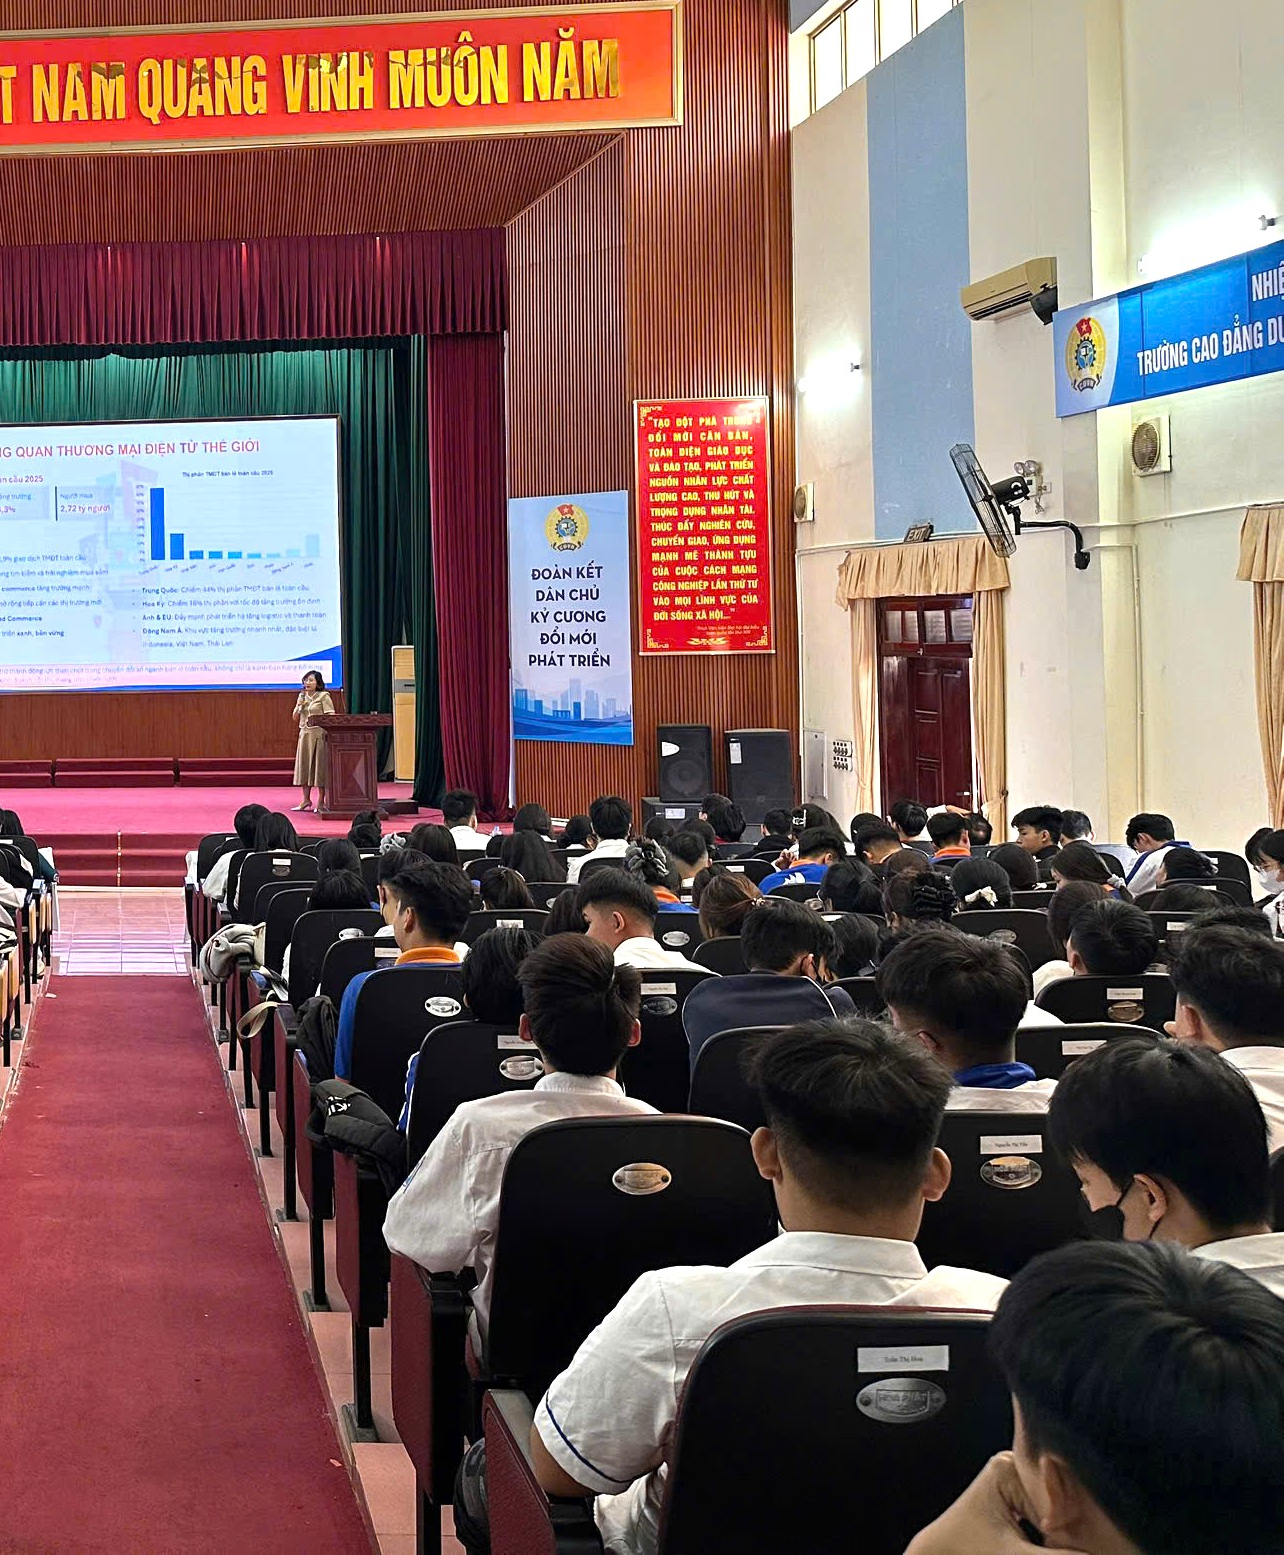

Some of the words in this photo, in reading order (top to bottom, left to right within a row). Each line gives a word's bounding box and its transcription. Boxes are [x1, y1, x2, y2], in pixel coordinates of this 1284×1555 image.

[33, 62, 126, 123] NAM
[138, 54, 267, 125] QUANG
[282, 51, 374, 113] VINH
[388, 31, 509, 109] MUÔN
[522, 25, 621, 102] NĂM
[1137, 337, 1188, 376] TRƯỜNG
[1192, 332, 1219, 363] CAO
[1223, 315, 1263, 356] ĐẲNG
[16, 446, 53, 458] QUAN
[57, 444, 114, 456] THƯƠNG
[118, 444, 141, 458] MẠI
[145, 443, 175, 457] ĐIỆN
[180, 439, 199, 453] TỬ
[202, 439, 227, 453] THẾ
[232, 438, 260, 452] GIỚI
[25, 475, 44, 483] 2025
[532, 564, 572, 580] ĐOÀN
[577, 560, 604, 579] KẾT
[536, 586, 565, 601] DÂN
[569, 584, 600, 600] CHỦ
[530, 607, 549, 624] KỶ
[553, 610, 606, 622] CƯƠNG
[540, 626, 565, 645] ĐỔI
[569, 629, 597, 644] MỚI
[529, 650, 565, 666] PHÁT
[570, 648, 610, 667] TRIỂN
